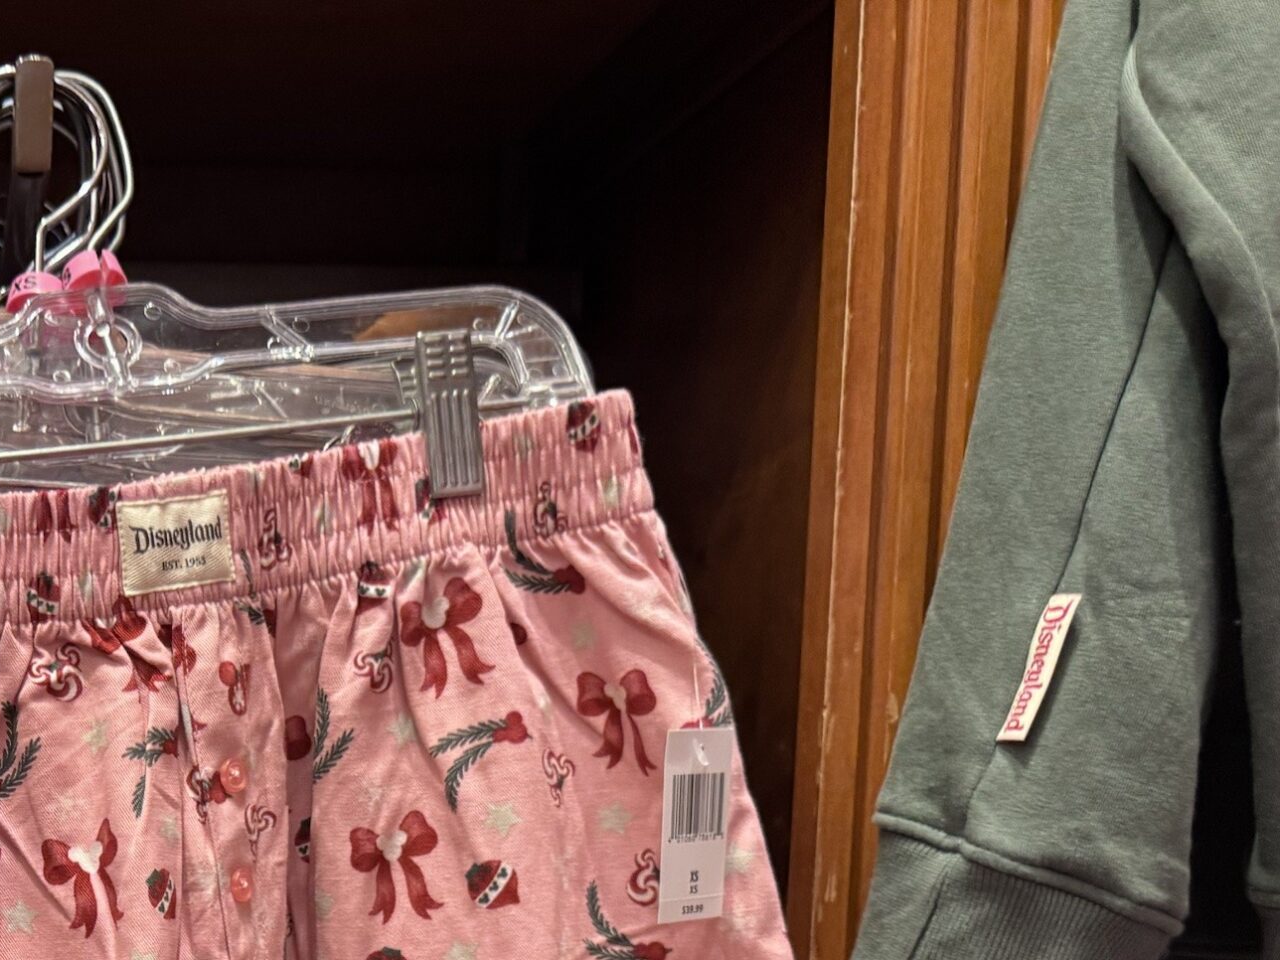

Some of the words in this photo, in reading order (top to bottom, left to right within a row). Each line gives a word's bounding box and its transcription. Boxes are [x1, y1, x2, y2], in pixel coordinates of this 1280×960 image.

[128, 515, 222, 555] Disneyland
[161, 560, 183, 571] EST.
[1005, 600, 1074, 732] Disneyland
[689, 870, 699, 882] XS
[689, 884, 698, 894] XS
